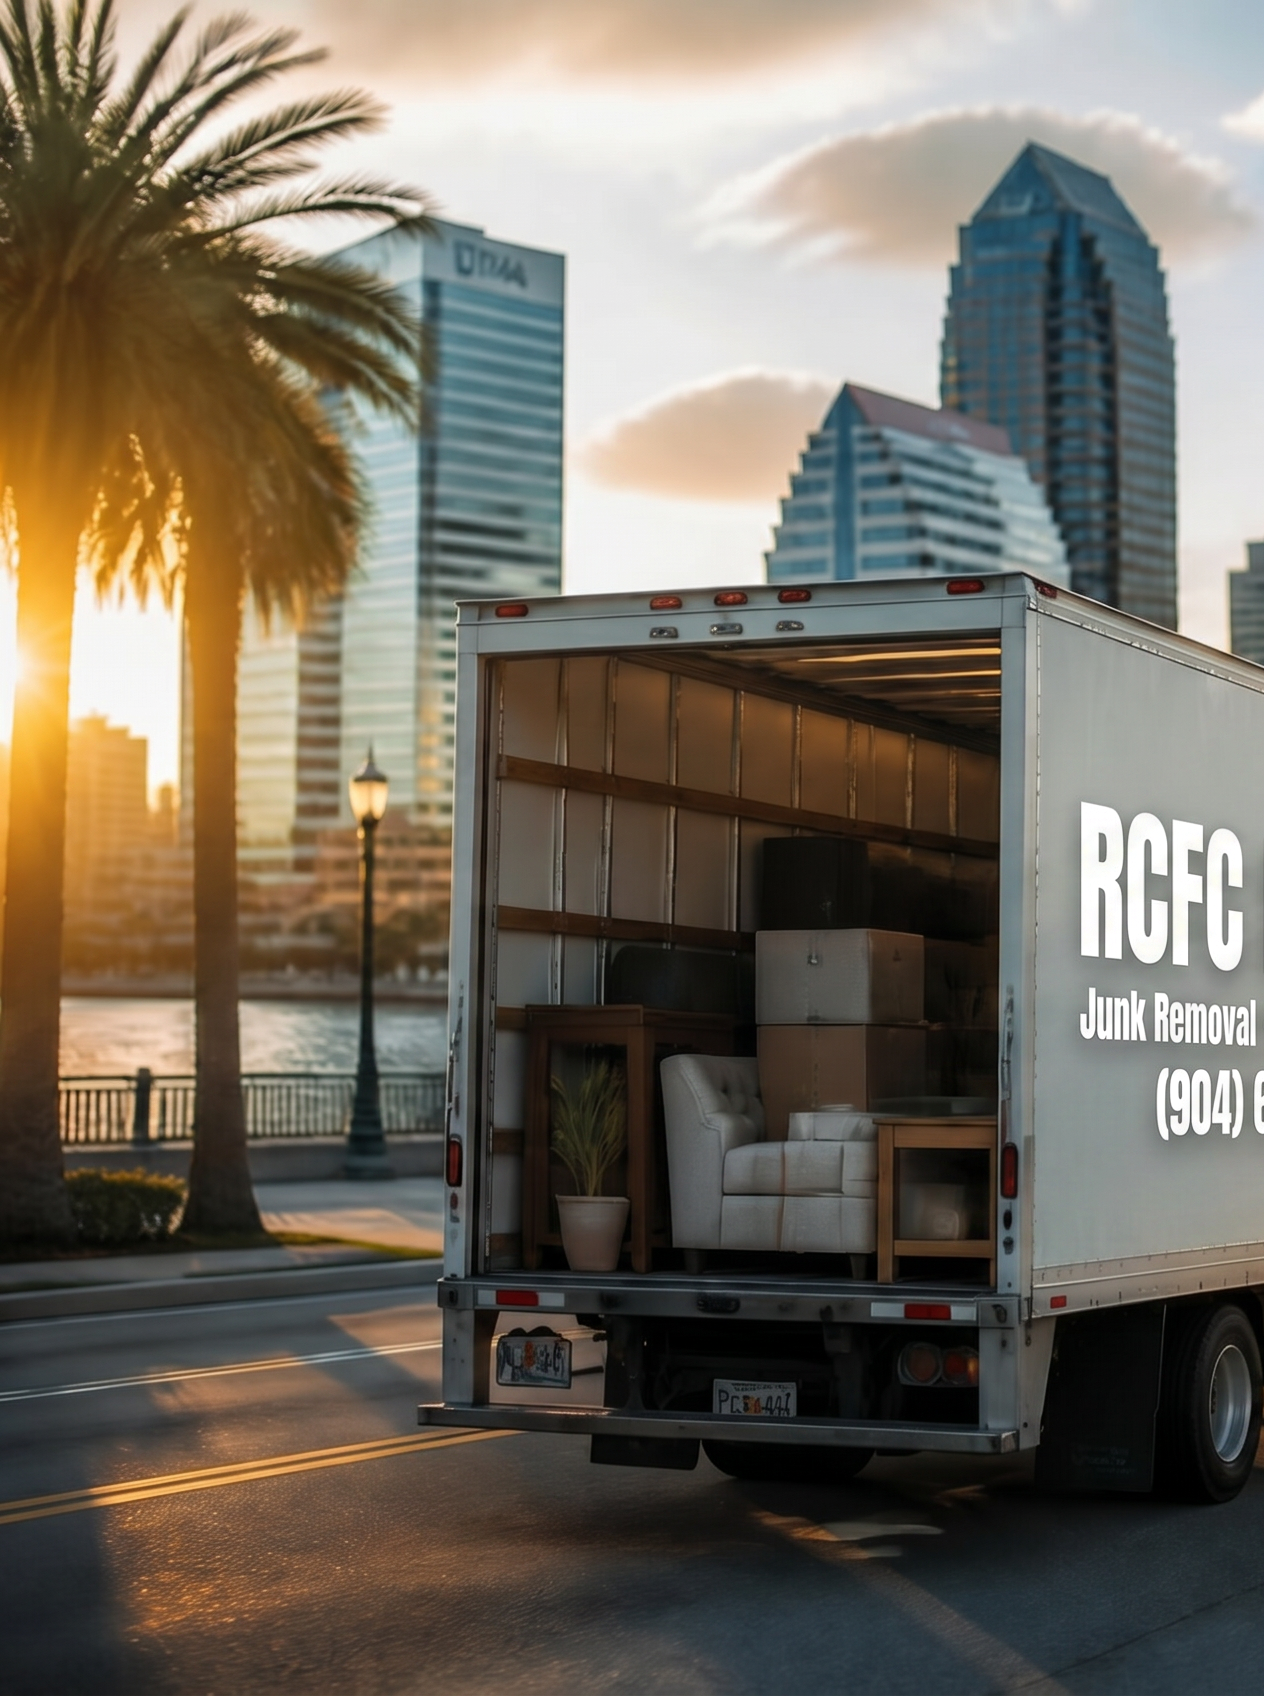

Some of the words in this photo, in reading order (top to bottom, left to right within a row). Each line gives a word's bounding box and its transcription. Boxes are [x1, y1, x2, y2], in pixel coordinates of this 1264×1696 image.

[1080, 801, 1243, 971] RCFC
[1080, 987, 1147, 1042] Junk
[1154, 992, 1256, 1047] Removal
[1156, 1067, 1244, 1141] (904)
